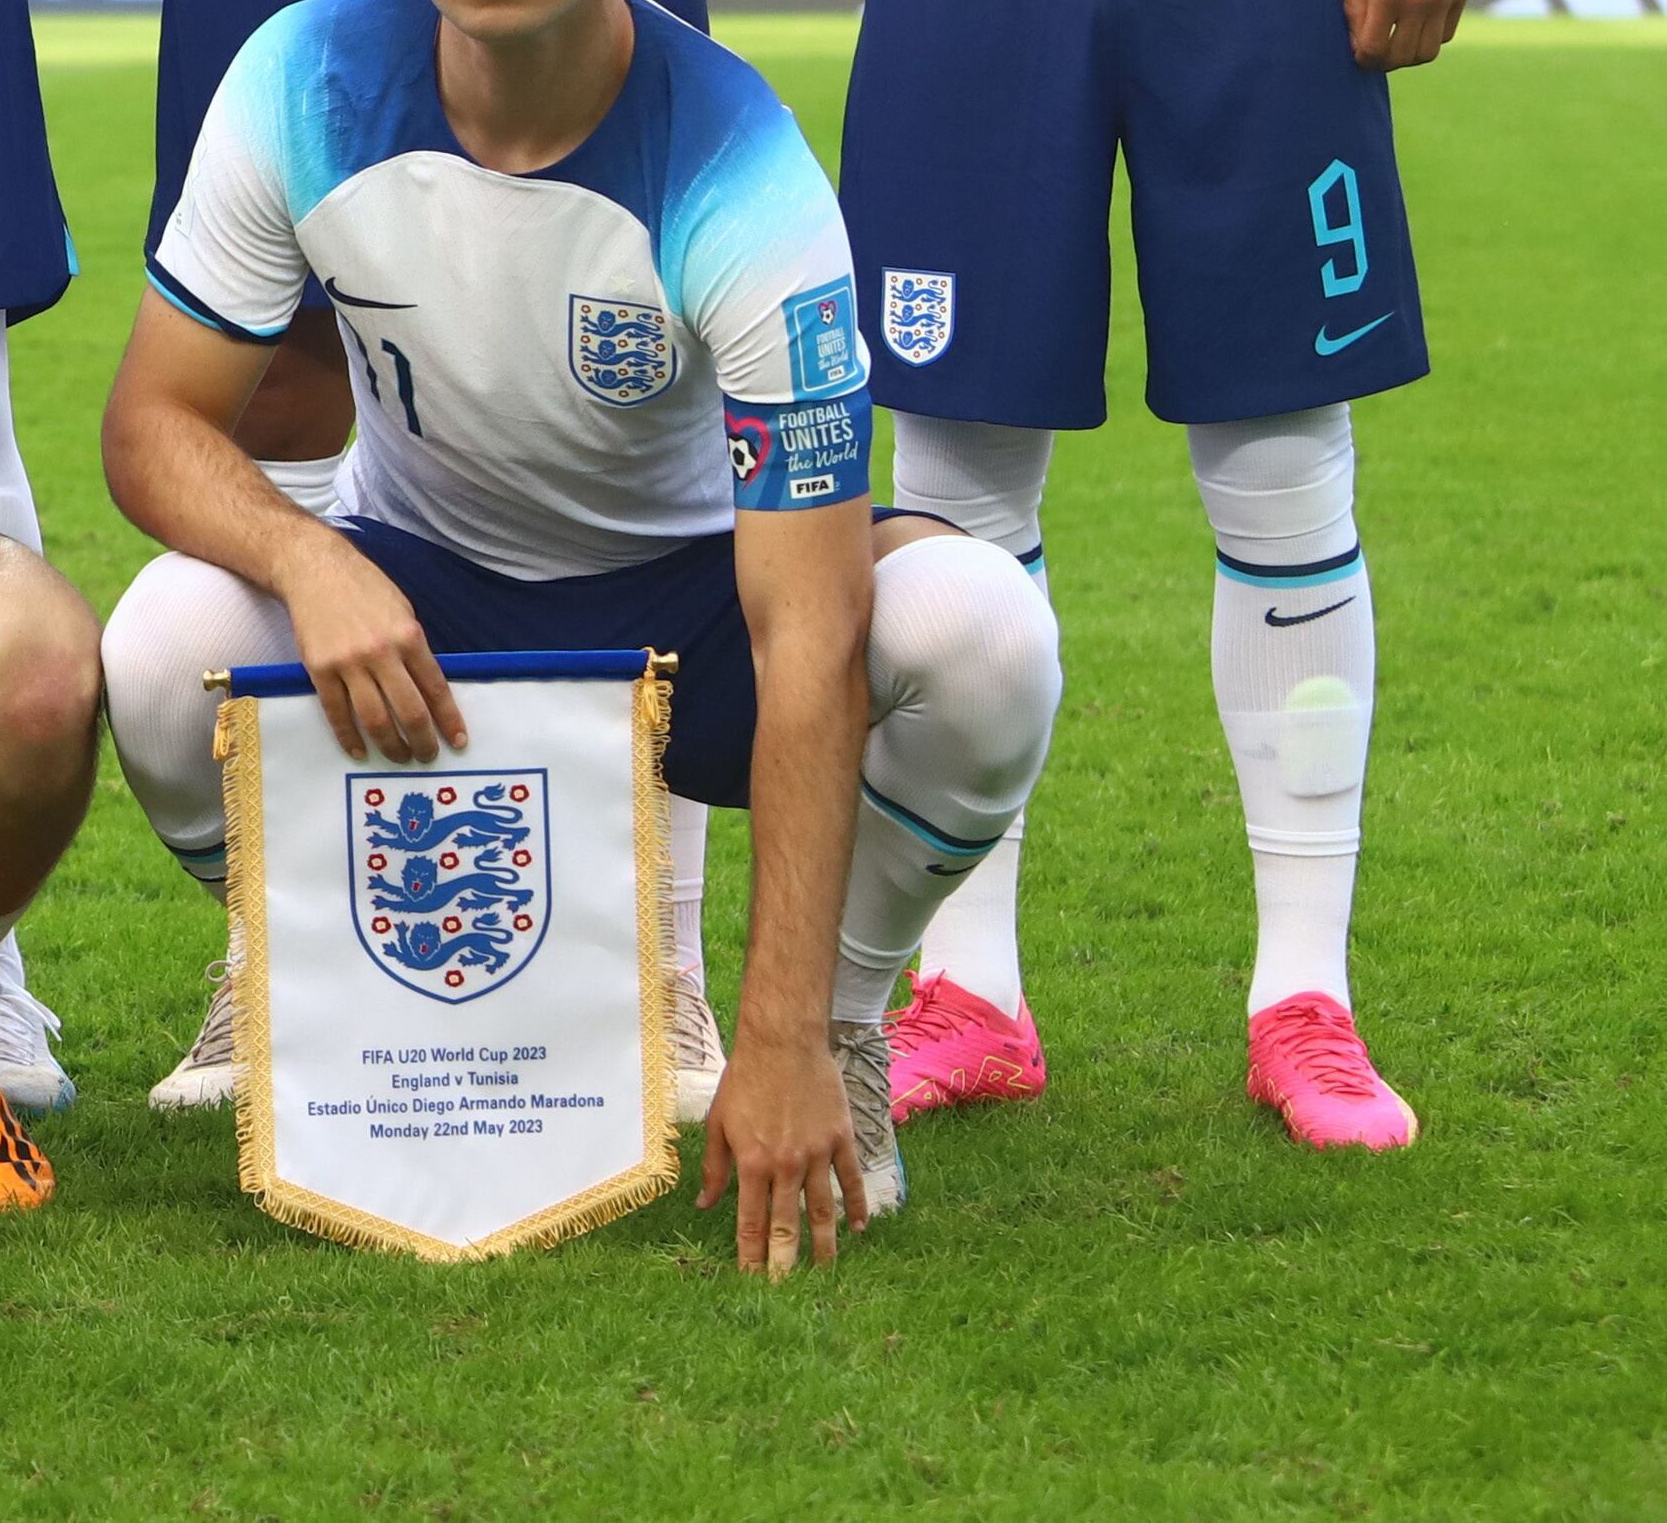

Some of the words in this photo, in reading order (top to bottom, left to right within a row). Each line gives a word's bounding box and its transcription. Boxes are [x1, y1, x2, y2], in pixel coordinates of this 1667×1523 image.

[1307, 158, 1370, 299] 9
[779, 402, 850, 430] FOOTBALL
[781, 418, 855, 452] UNITES
[785, 452, 814, 473] the
[815, 441, 859, 468] World
[796, 480, 829, 494] FIFA
[362, 1050, 394, 1064] FIFA
[398, 1049, 427, 1064] U20
[431, 1047, 474, 1063] World
[479, 1047, 508, 1064] Cup
[513, 1046, 547, 1061] 2023
[392, 1072, 450, 1091] England
[455, 1075, 463, 1086] v
[468, 1071, 519, 1086] Tunisia
[308, 1100, 362, 1116] Estadio
[366, 1094, 408, 1114] Único
[412, 1097, 454, 1115] Diego
[459, 1095, 526, 1111] Armando
[531, 1093, 605, 1109] Maradona
[370, 1123, 429, 1140] Monday
[433, 1121, 468, 1137] 22nd
[473, 1119, 505, 1137] May
[509, 1118, 543, 1134] 2023
